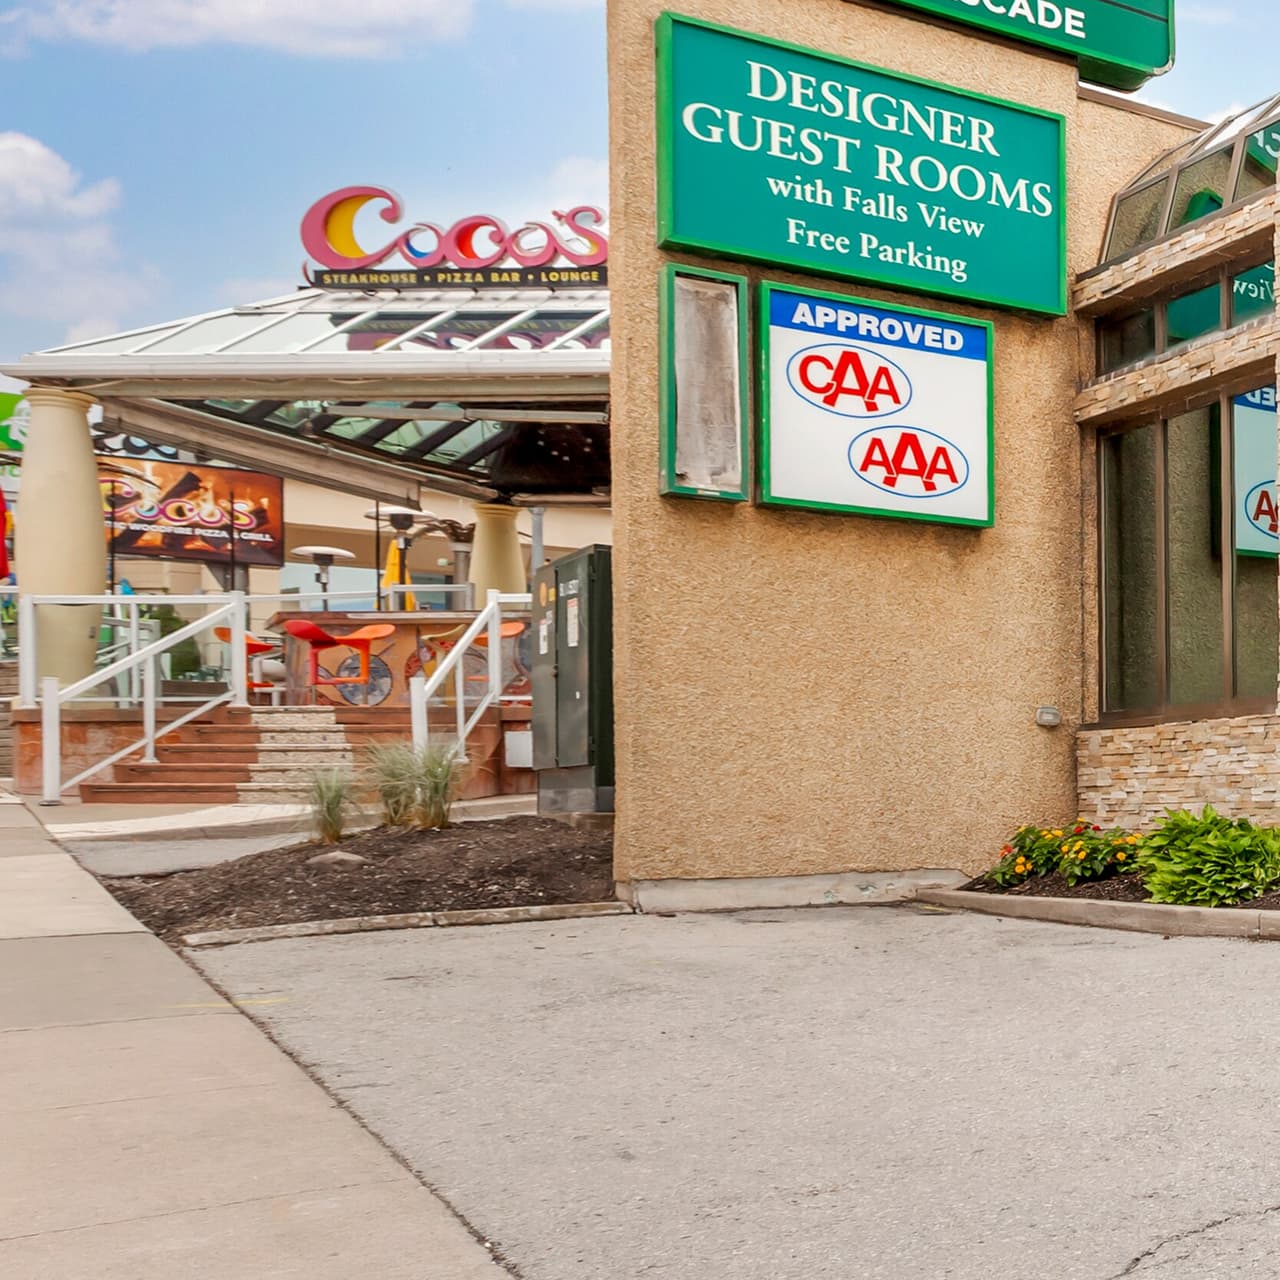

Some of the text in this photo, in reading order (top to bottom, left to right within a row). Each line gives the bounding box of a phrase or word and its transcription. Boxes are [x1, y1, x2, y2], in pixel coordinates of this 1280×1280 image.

[746, 60, 1001, 157] DESIGNER
[681, 103, 1053, 217] GUEST ROOMS
[767, 176, 985, 238] with Falls View
[322, 270, 600, 284] STEAKHOUSE PIZZA BAR LOUNGE
[787, 218, 969, 283] Free Parking
[791, 302, 964, 351] APPROVED
[798, 350, 902, 412] CAA
[860, 431, 958, 492] AAA
[194, 528, 230, 538] PIZZA
